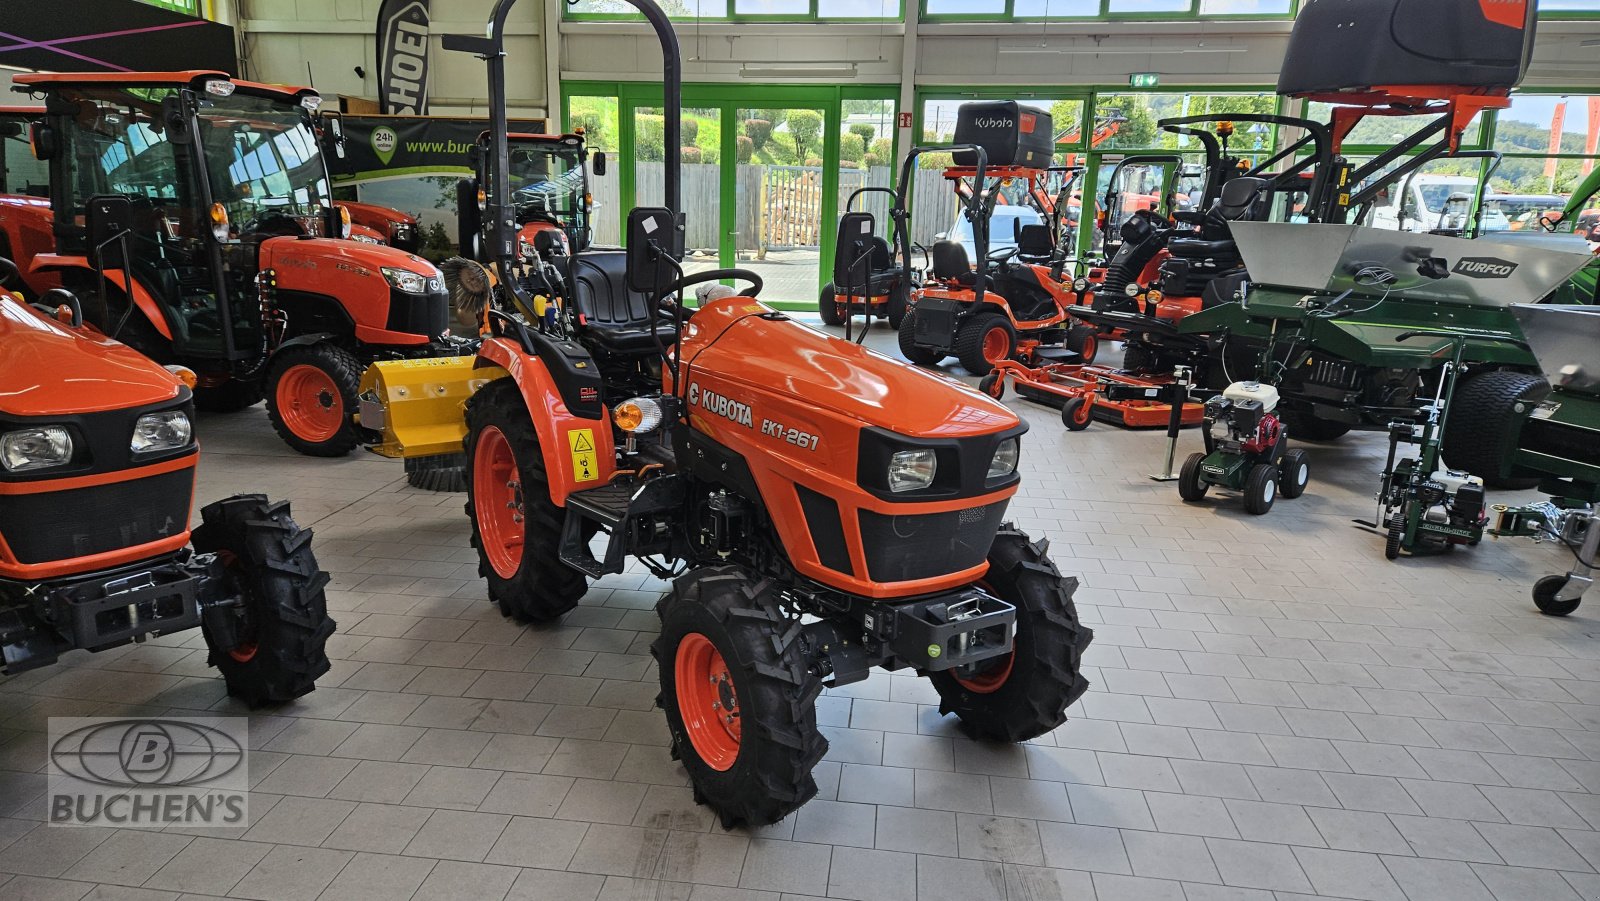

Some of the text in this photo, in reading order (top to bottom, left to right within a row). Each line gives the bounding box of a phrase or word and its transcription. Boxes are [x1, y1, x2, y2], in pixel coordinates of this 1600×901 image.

[975, 117, 1013, 128] Kubota
[375, 132, 393, 142] 24h
[1459, 260, 1512, 276] TURFCO
[702, 389, 819, 451] KUBOTA EK1-261
